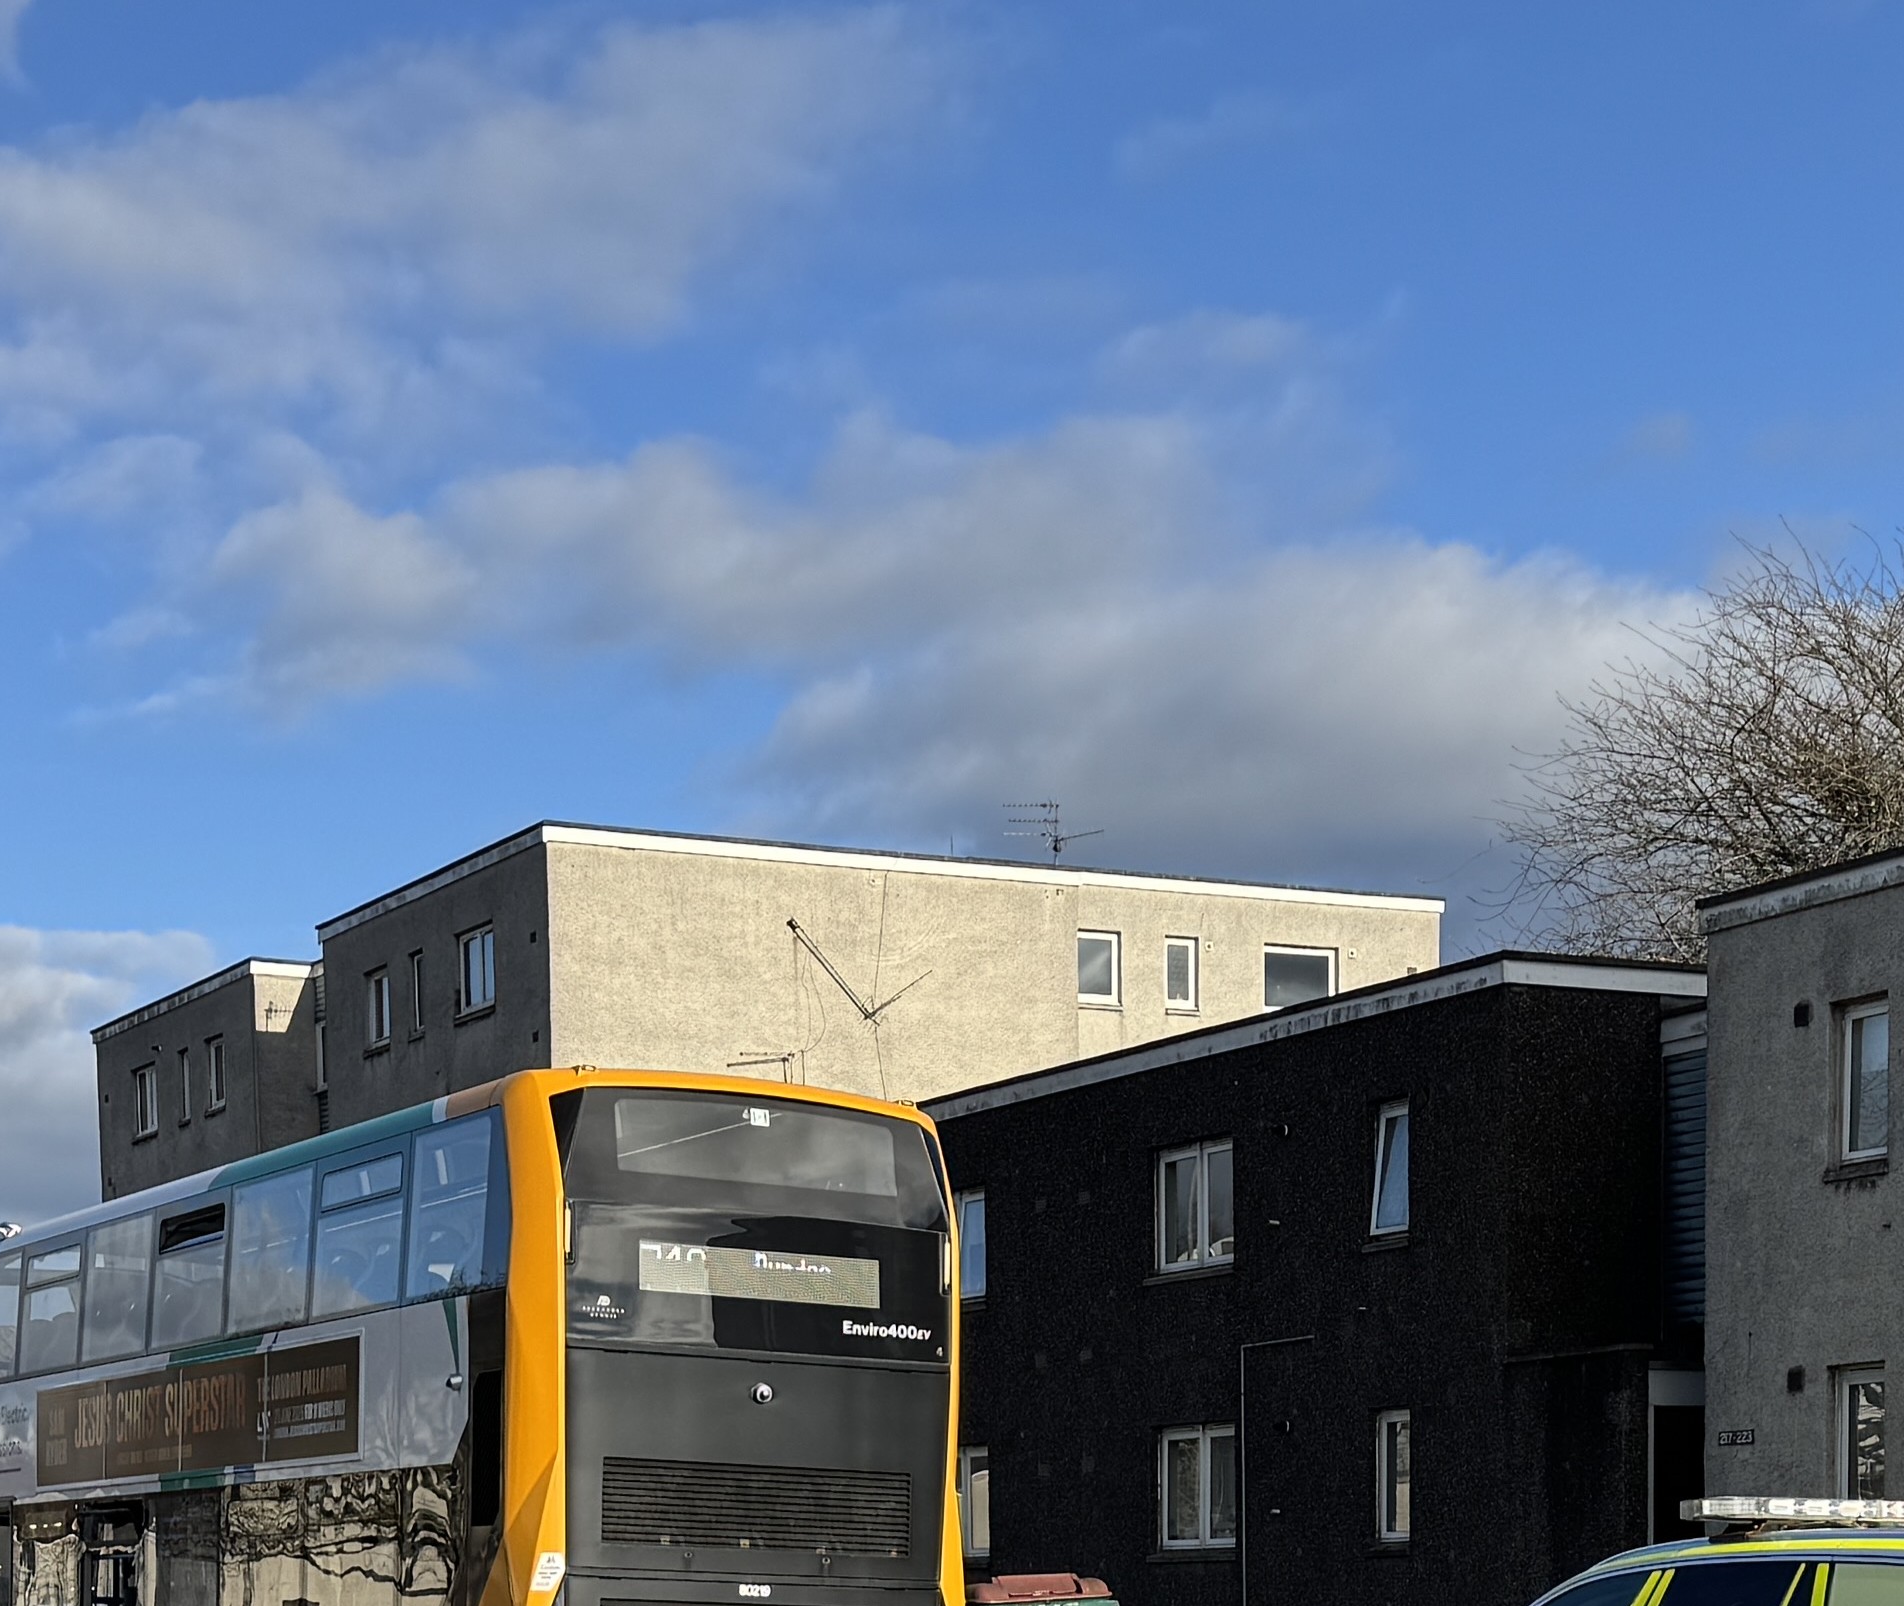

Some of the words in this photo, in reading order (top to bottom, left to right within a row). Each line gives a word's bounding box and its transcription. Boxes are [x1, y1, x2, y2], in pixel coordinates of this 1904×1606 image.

[74, 1391, 113, 1449] JESUS
[116, 1384, 163, 1443] CHRIST
[165, 1372, 246, 1437] SUPERSTAR
